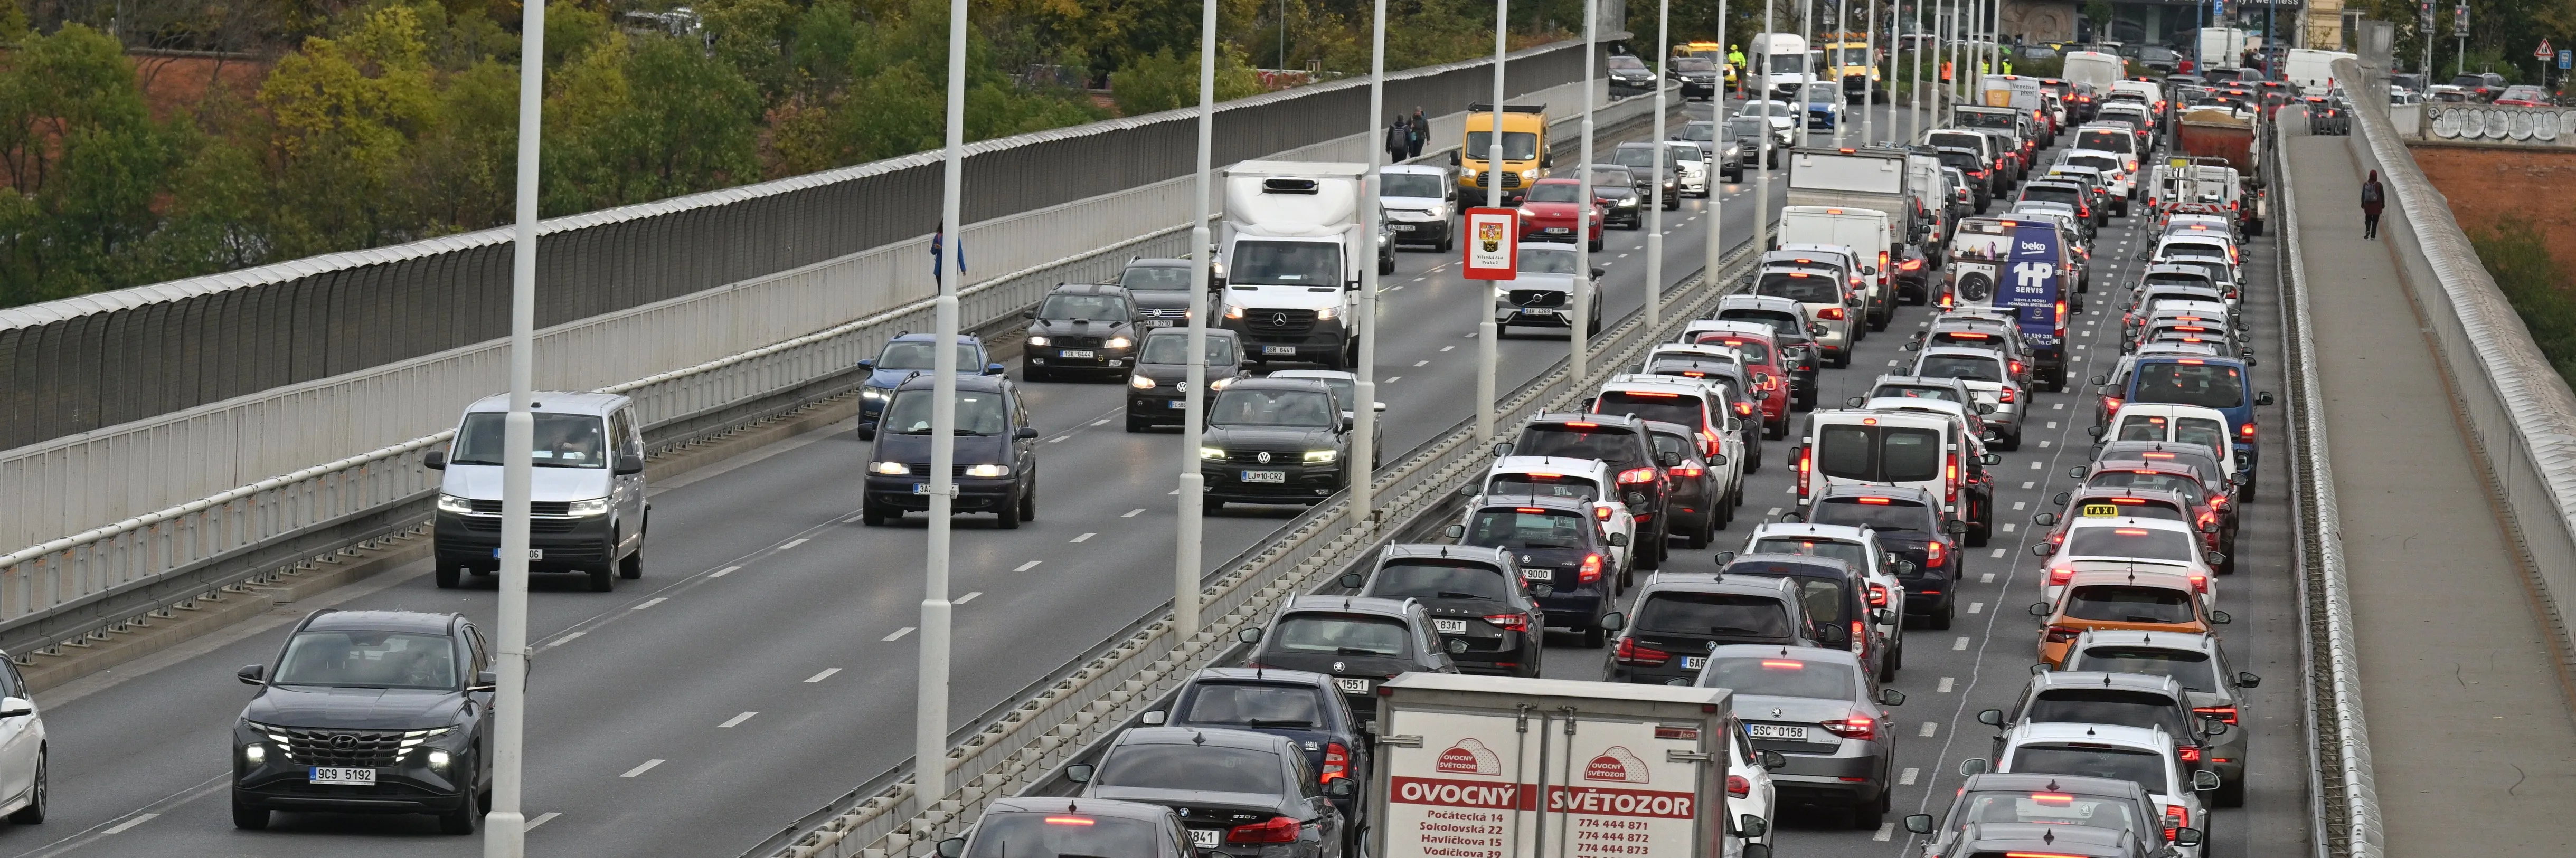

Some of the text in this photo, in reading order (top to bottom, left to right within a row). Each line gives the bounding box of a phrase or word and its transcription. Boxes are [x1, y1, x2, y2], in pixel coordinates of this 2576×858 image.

[2022, 241, 2045, 250] beko
[1528, 570, 1548, 579] 9000
[1440, 621, 1462, 630] 83AT
[1342, 679, 1364, 690] 1551
[1753, 726, 1803, 737] 5SC 0158
[1439, 761, 1476, 770] SVĚTOZOR
[318, 769, 337, 779] 9C9
[346, 769, 371, 780] 5192
[1401, 782, 1690, 816] OVOCNÝ SVĚTOZOR
[1428, 810, 1503, 822] Počátecká 14
[1420, 822, 1503, 835] Sokolovská 22
[1579, 819, 1648, 830] 774 444 871
[1421, 834, 1502, 847] Havlíčkova 15
[1578, 831, 1649, 843] 774 444 872
[1423, 846, 1483, 858] Vodičkova
[1578, 843, 1648, 855] 774 444 873
